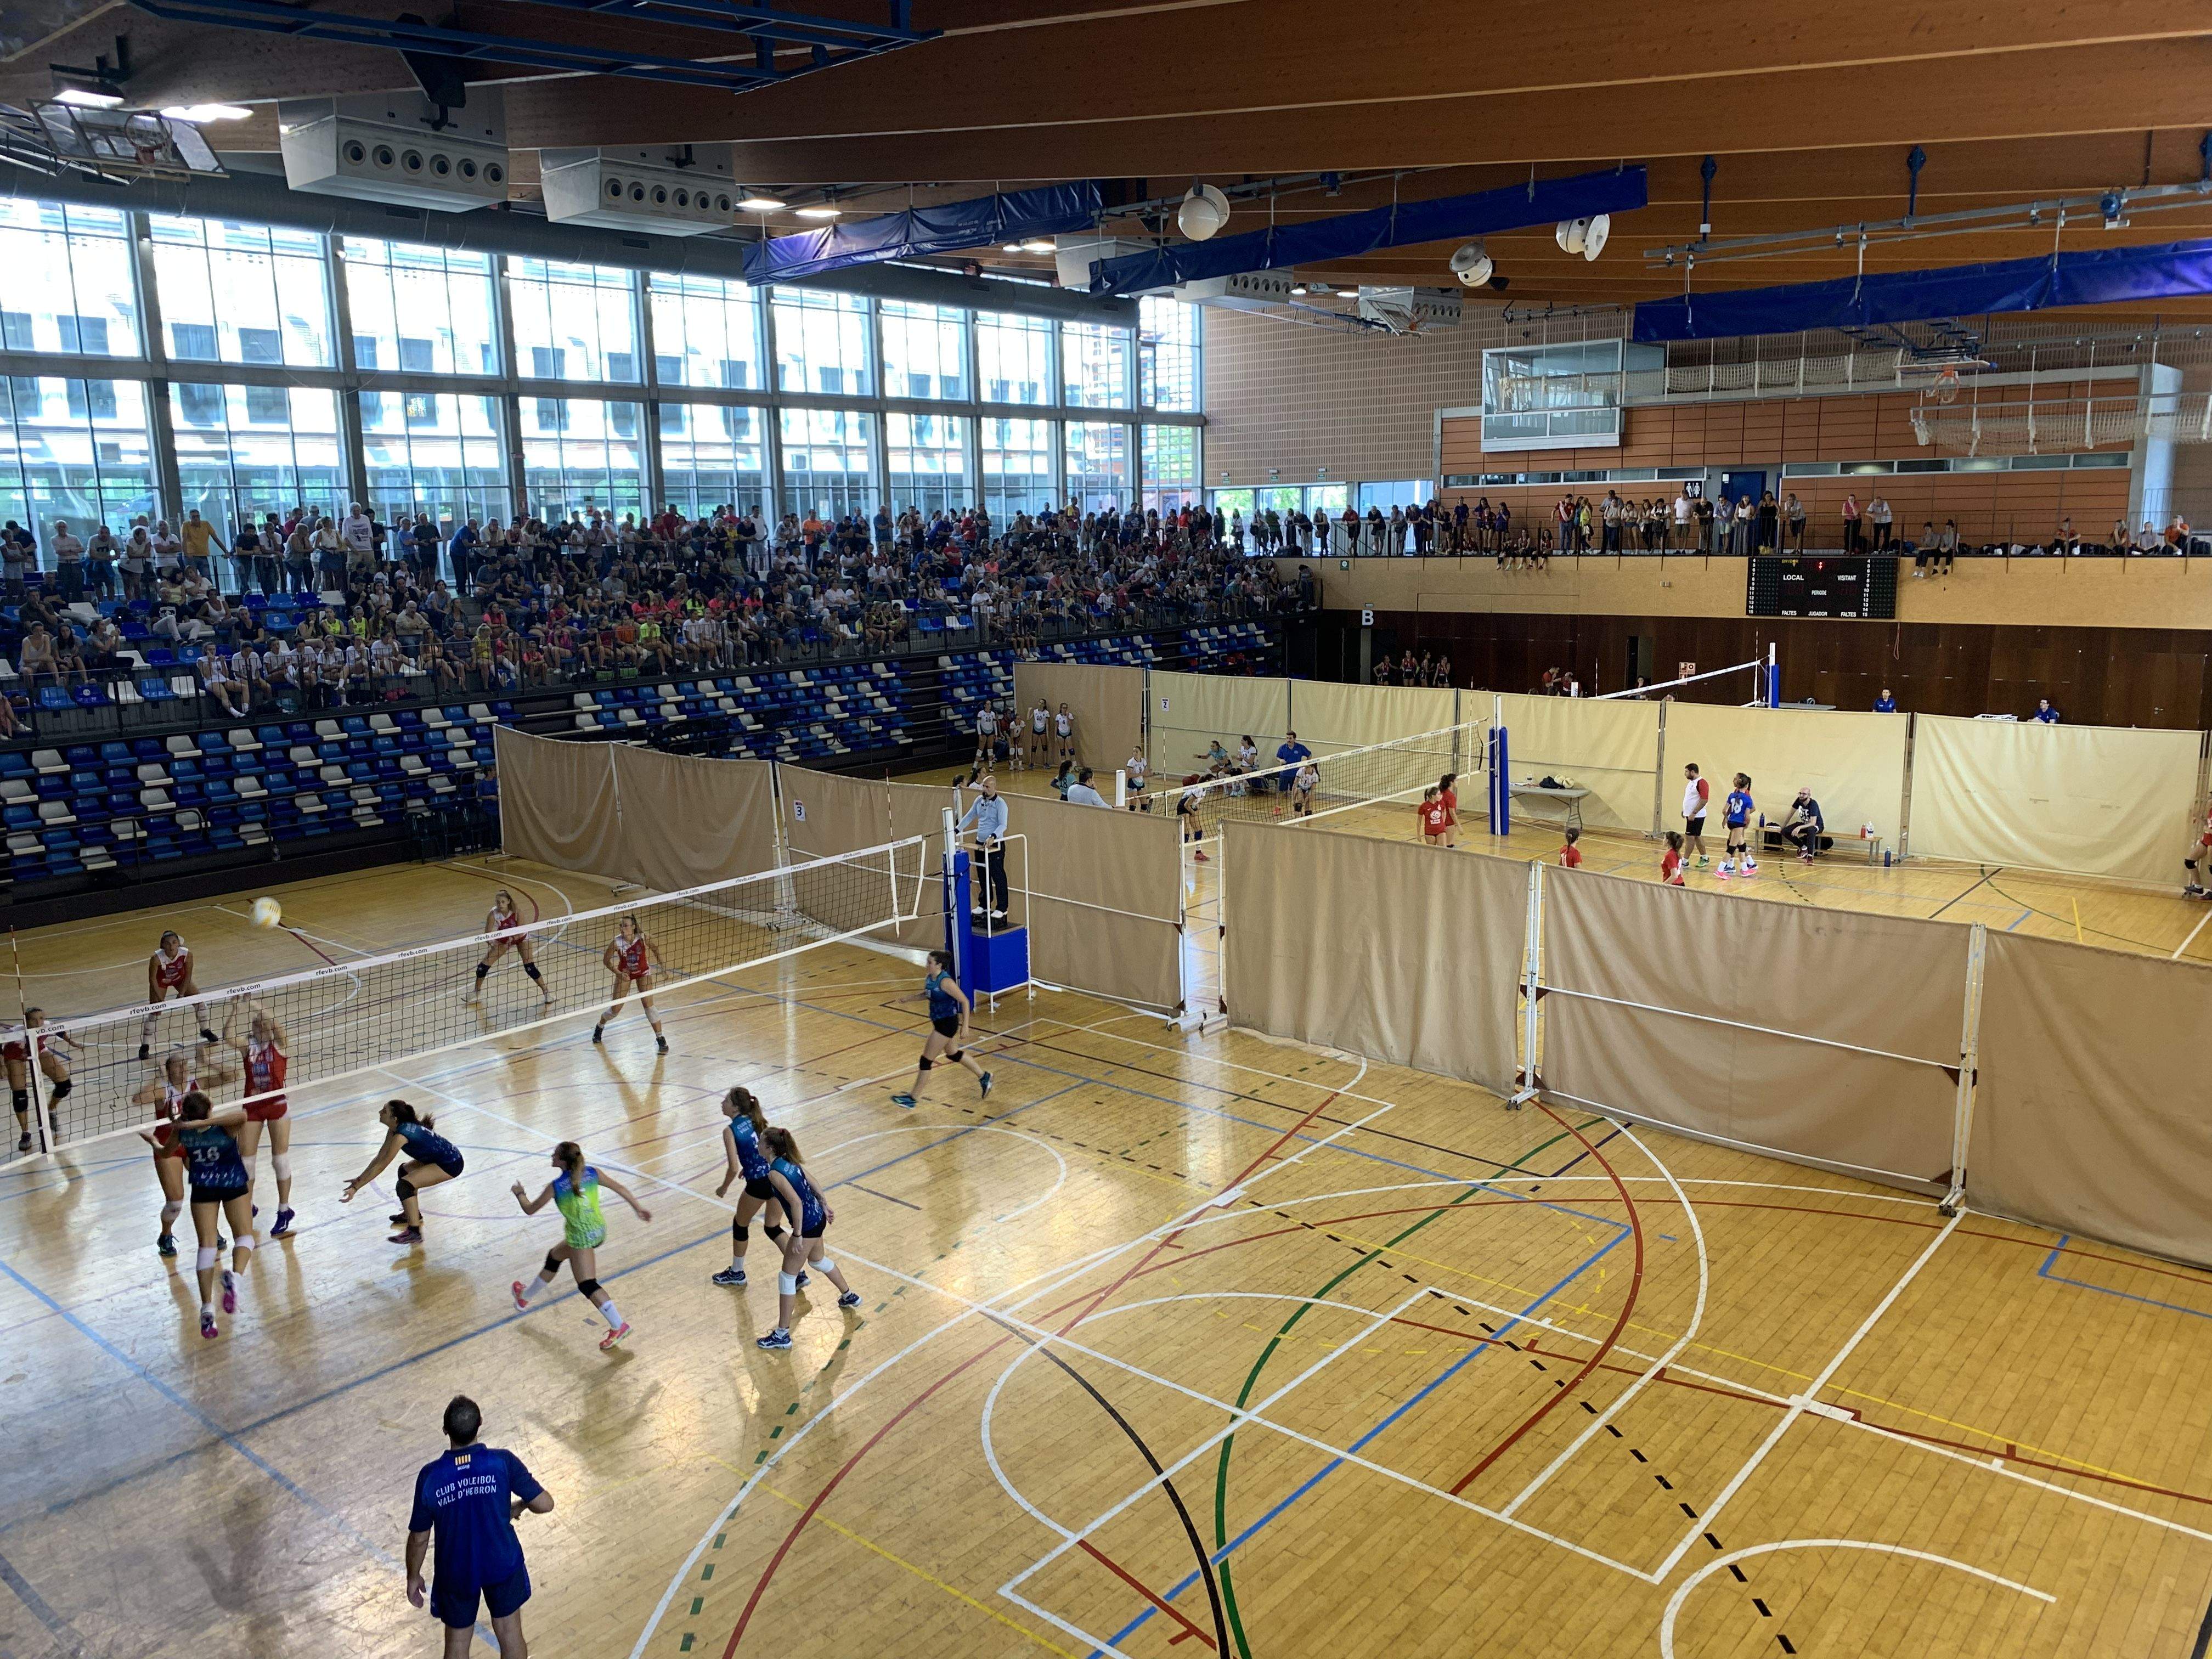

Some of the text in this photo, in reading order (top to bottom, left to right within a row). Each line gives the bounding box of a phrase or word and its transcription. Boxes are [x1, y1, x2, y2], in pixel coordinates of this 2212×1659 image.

[1362, 610, 1374, 625] B
[797, 806, 802, 816] 3
[1730, 798, 1743, 814] 18
[613, 902, 638, 911] rfevb.com
[546, 916, 572, 926] rfevb.com
[475, 932, 503, 941] rfevb.com
[398, 947, 428, 958] rfevb.com
[315, 965, 348, 976] rfevb.com
[227, 983, 261, 995] rfevb.com
[129, 1002, 167, 1015] rfevb.com
[436, 1475, 496, 1498] CLUB VOLEIBOL
[438, 1485, 496, 1507] VALL D'HEBRON
